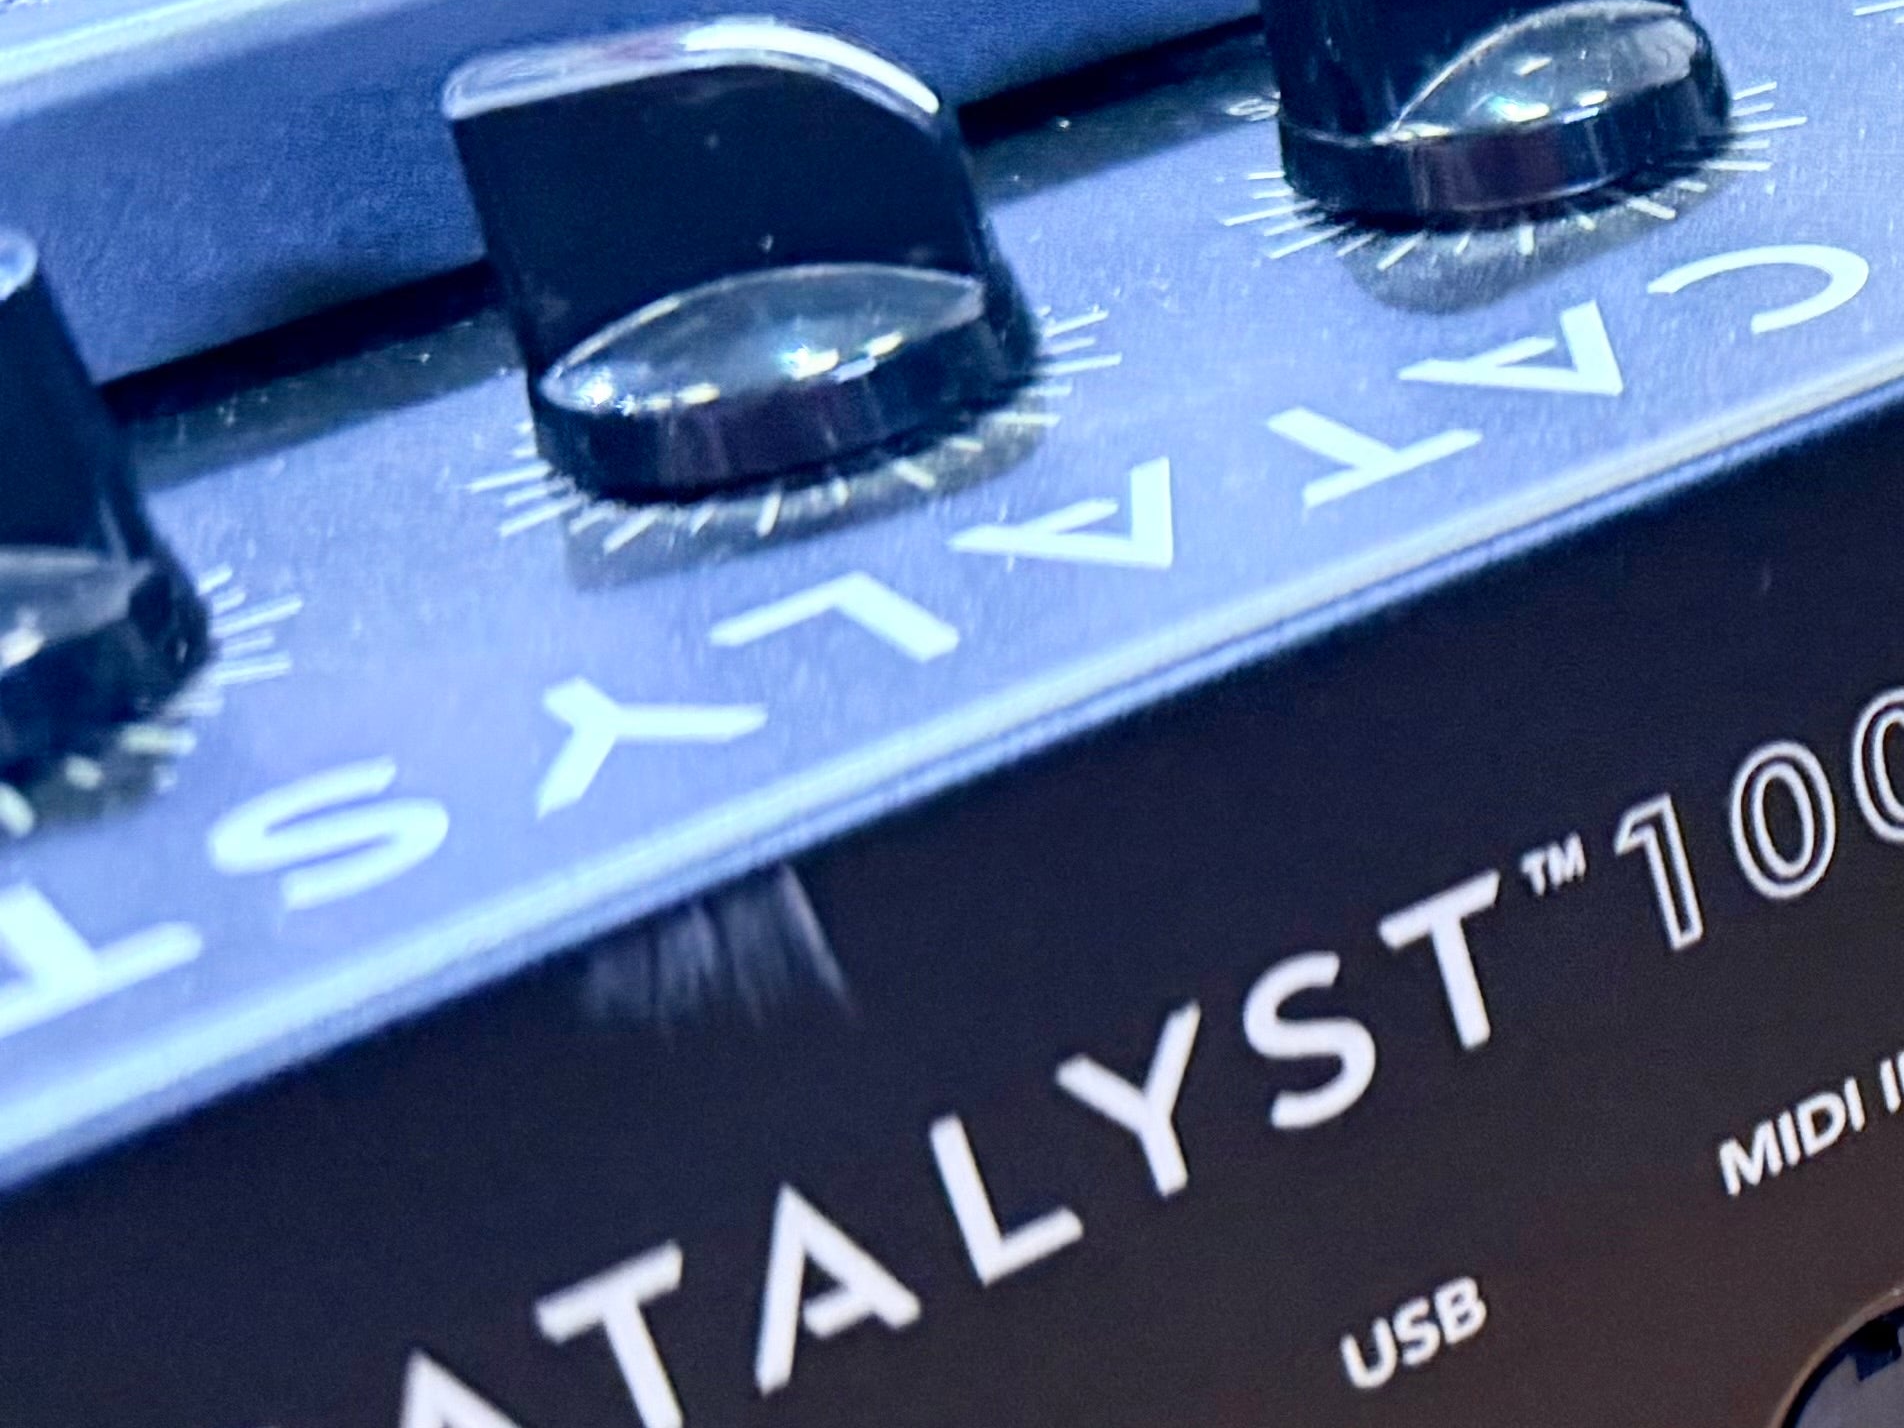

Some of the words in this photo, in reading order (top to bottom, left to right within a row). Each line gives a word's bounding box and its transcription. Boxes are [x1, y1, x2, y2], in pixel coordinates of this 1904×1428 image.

[0, 242, 1870, 1037] CATALYST
[1719, 1094, 1866, 1197] MIDI
[1340, 1277, 1488, 1390] USB
